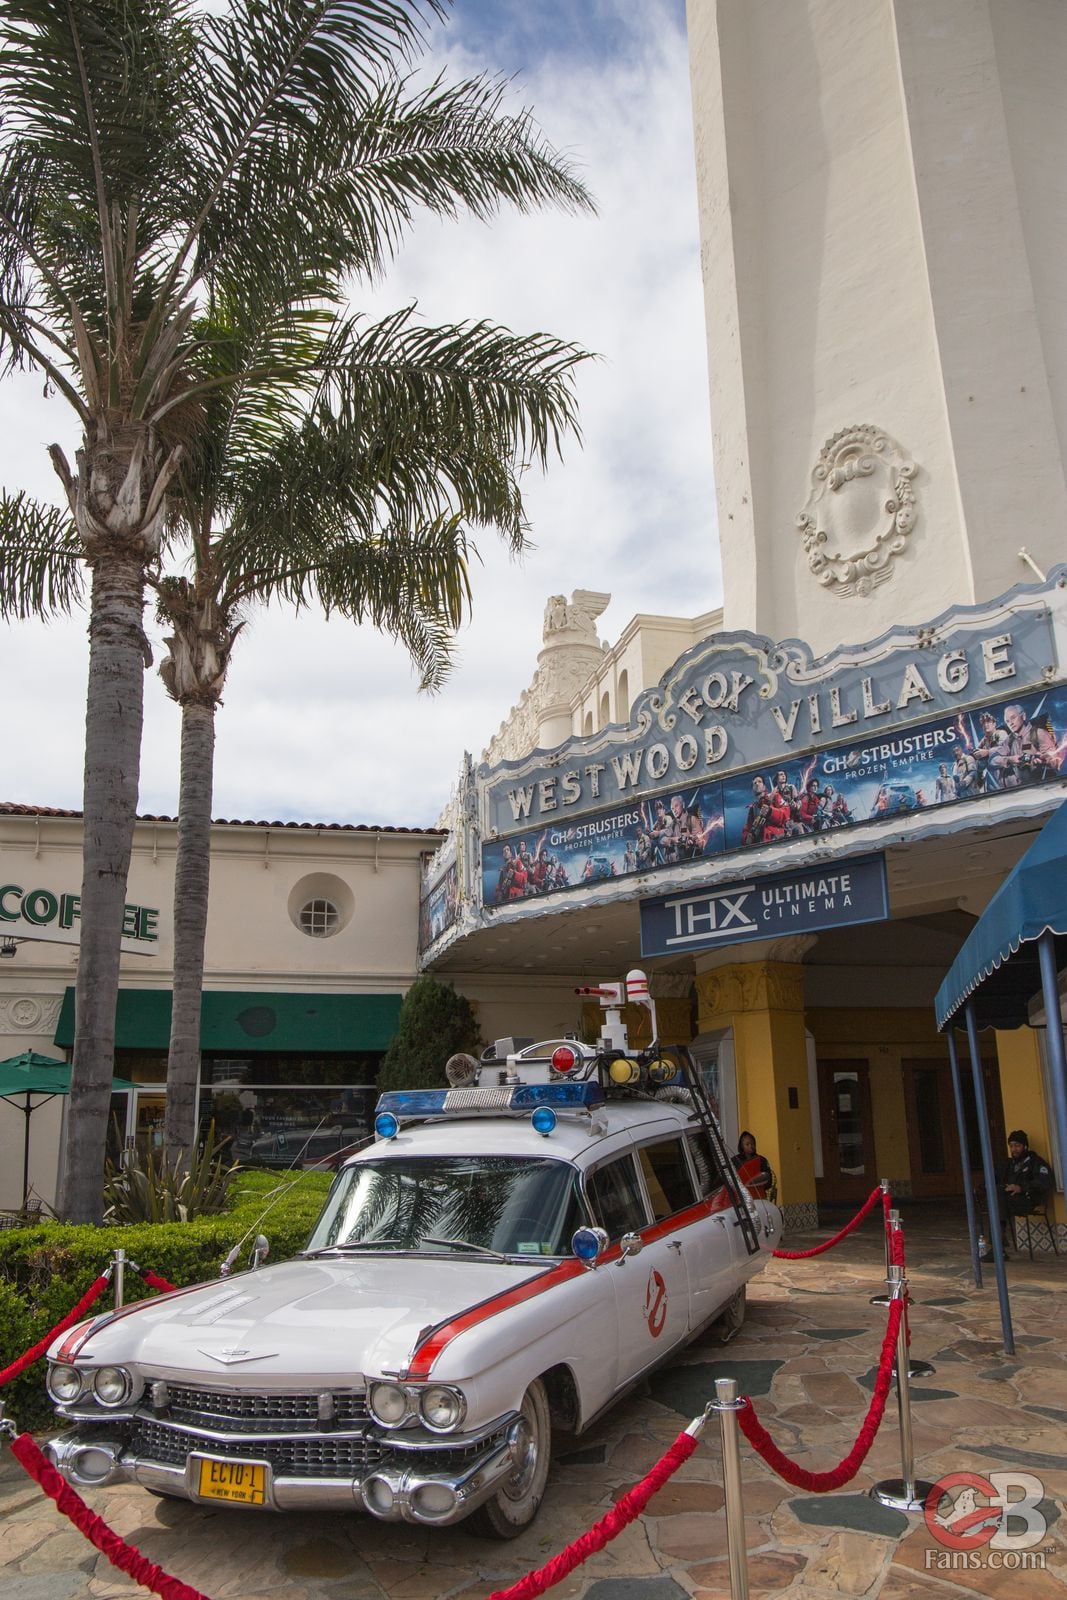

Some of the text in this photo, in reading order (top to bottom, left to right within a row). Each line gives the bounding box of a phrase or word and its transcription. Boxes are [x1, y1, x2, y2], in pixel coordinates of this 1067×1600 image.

[678, 671, 754, 725] FOX
[507, 633, 1017, 820] WESTWOOD VILLAGE
[845, 750, 935, 780] FROZEN EMPIRE
[565, 829, 624, 851] FROZEN EMPIRE
[664, 884, 757, 937] THX
[761, 874, 852, 907] ULTIMATE
[763, 894, 852, 920] CINEMA
[0, 883, 160, 942] COFEE
